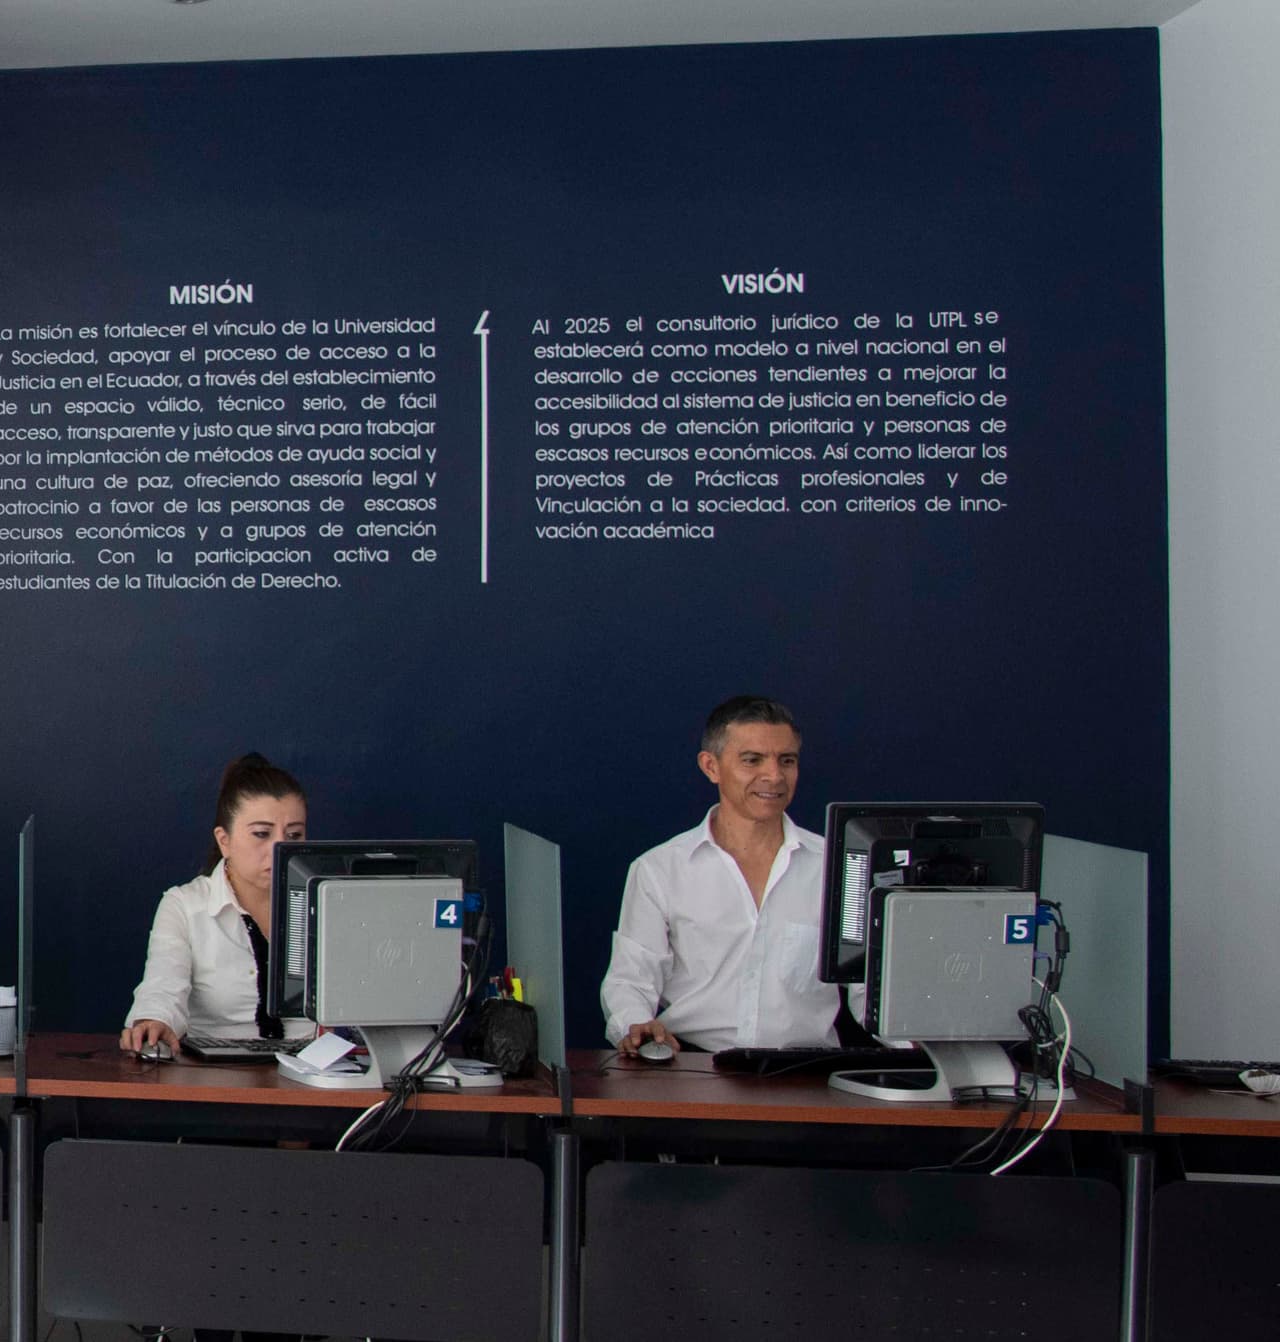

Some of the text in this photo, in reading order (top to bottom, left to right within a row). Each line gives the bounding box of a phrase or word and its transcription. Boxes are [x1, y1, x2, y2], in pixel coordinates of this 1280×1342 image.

[721, 267, 804, 294] VISIÓN
[170, 278, 253, 305] MISIÓN
[19, 324, 73, 340] misión
[78, 327, 98, 339] es
[104, 323, 187, 338] fortalecer
[192, 321, 208, 336] el
[213, 320, 276, 336] vínculo
[281, 320, 307, 335] de
[312, 319, 329, 335] la
[335, 317, 435, 334] Universidad
[532, 311, 999, 335] Al 2025 el consultorio jurídico de la UTPL se
[534, 337, 1006, 359] establecerá como modelo a nivel nacional en el
[60, 377, 82, 389] en
[87, 374, 102, 388] el
[106, 372, 182, 388] Ecuador,
[188, 374, 201, 387] a
[204, 369, 256, 386] través
[260, 370, 288, 386] del
[292, 368, 436, 385] establecimiento
[534, 364, 1006, 384] desarrollo de acciones tendientes a mejorar la
[30, 402, 52, 415] un
[64, 398, 135, 416] espacio
[147, 396, 203, 413] válido,
[217, 395, 285, 411] técnico
[302, 395, 347, 411] serio,
[361, 394, 386, 410] de
[399, 392, 437, 409] fácil
[534, 390, 1007, 411] accesibilidad al sistema de justicia en beneficio de
[67, 423, 176, 442] transparente
[179, 426, 190, 440] y
[193, 422, 233, 440] justo
[237, 424, 272, 440] que
[276, 421, 315, 437] sirva
[320, 423, 362, 439] para
[366, 419, 436, 437] trabajar
[535, 417, 1007, 439] los grupos de atención prioritaria y personas de
[26, 450, 41, 465] la
[46, 447, 161, 467] implantación
[165, 448, 190, 463] de
[194, 446, 274, 462] métodos
[278, 446, 303, 462] de
[307, 445, 365, 464] ayuda
[369, 444, 421, 461] social
[425, 448, 437, 464] y
[535, 448, 609, 462] escasos
[614, 448, 689, 461] recursos
[822, 442, 848, 460] Así
[854, 446, 912, 460] como
[918, 443, 976, 459] liderar
[982, 443, 1007, 459] los
[36, 475, 94, 490] cultura
[104, 474, 128, 489] de
[138, 476, 173, 491] paz,
[184, 472, 280, 488] ofreciendo
[290, 469, 362, 487] asesoría
[372, 470, 417, 489] legal
[425, 472, 437, 488] y
[89, 502, 101, 514] a
[110, 499, 154, 514] favor
[163, 498, 188, 513] de
[197, 498, 221, 513] las
[231, 499, 310, 516] personas
[319, 496, 345, 512] de
[364, 497, 437, 511] escasos
[535, 496, 641, 514] Vinculación
[650, 500, 663, 513] a
[672, 497, 689, 513] la
[800, 499, 837, 513] con
[845, 496, 916, 512] criterios
[925, 496, 952, 512] de
[960, 496, 1007, 512] inno-
[535, 521, 714, 539] vación académica
[96, 574, 120, 589] de
[125, 574, 141, 589] la
[145, 573, 226, 589] Titulación
[231, 573, 256, 589] de
[261, 573, 341, 588] Derecho.
[440, 904, 458, 924] 4
[1012, 919, 1028, 939] 5
